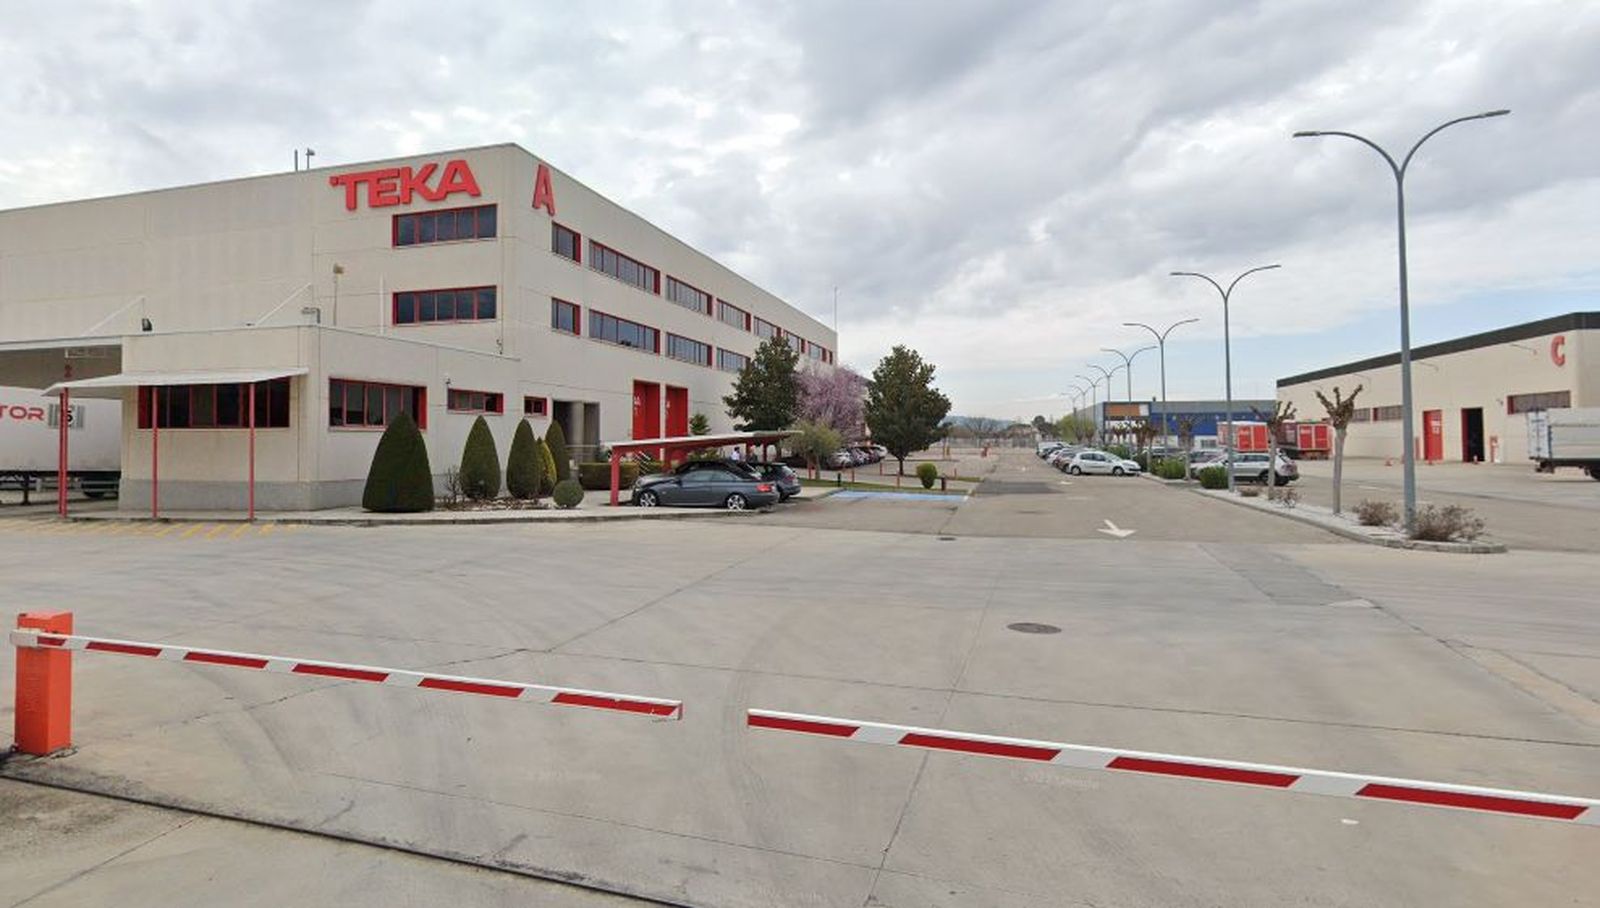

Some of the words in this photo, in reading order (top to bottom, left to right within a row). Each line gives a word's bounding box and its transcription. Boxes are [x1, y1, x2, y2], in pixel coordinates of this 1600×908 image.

[330, 160, 482, 211] TEKA
[532, 164, 556, 216] A
[1551, 335, 1565, 366] C
